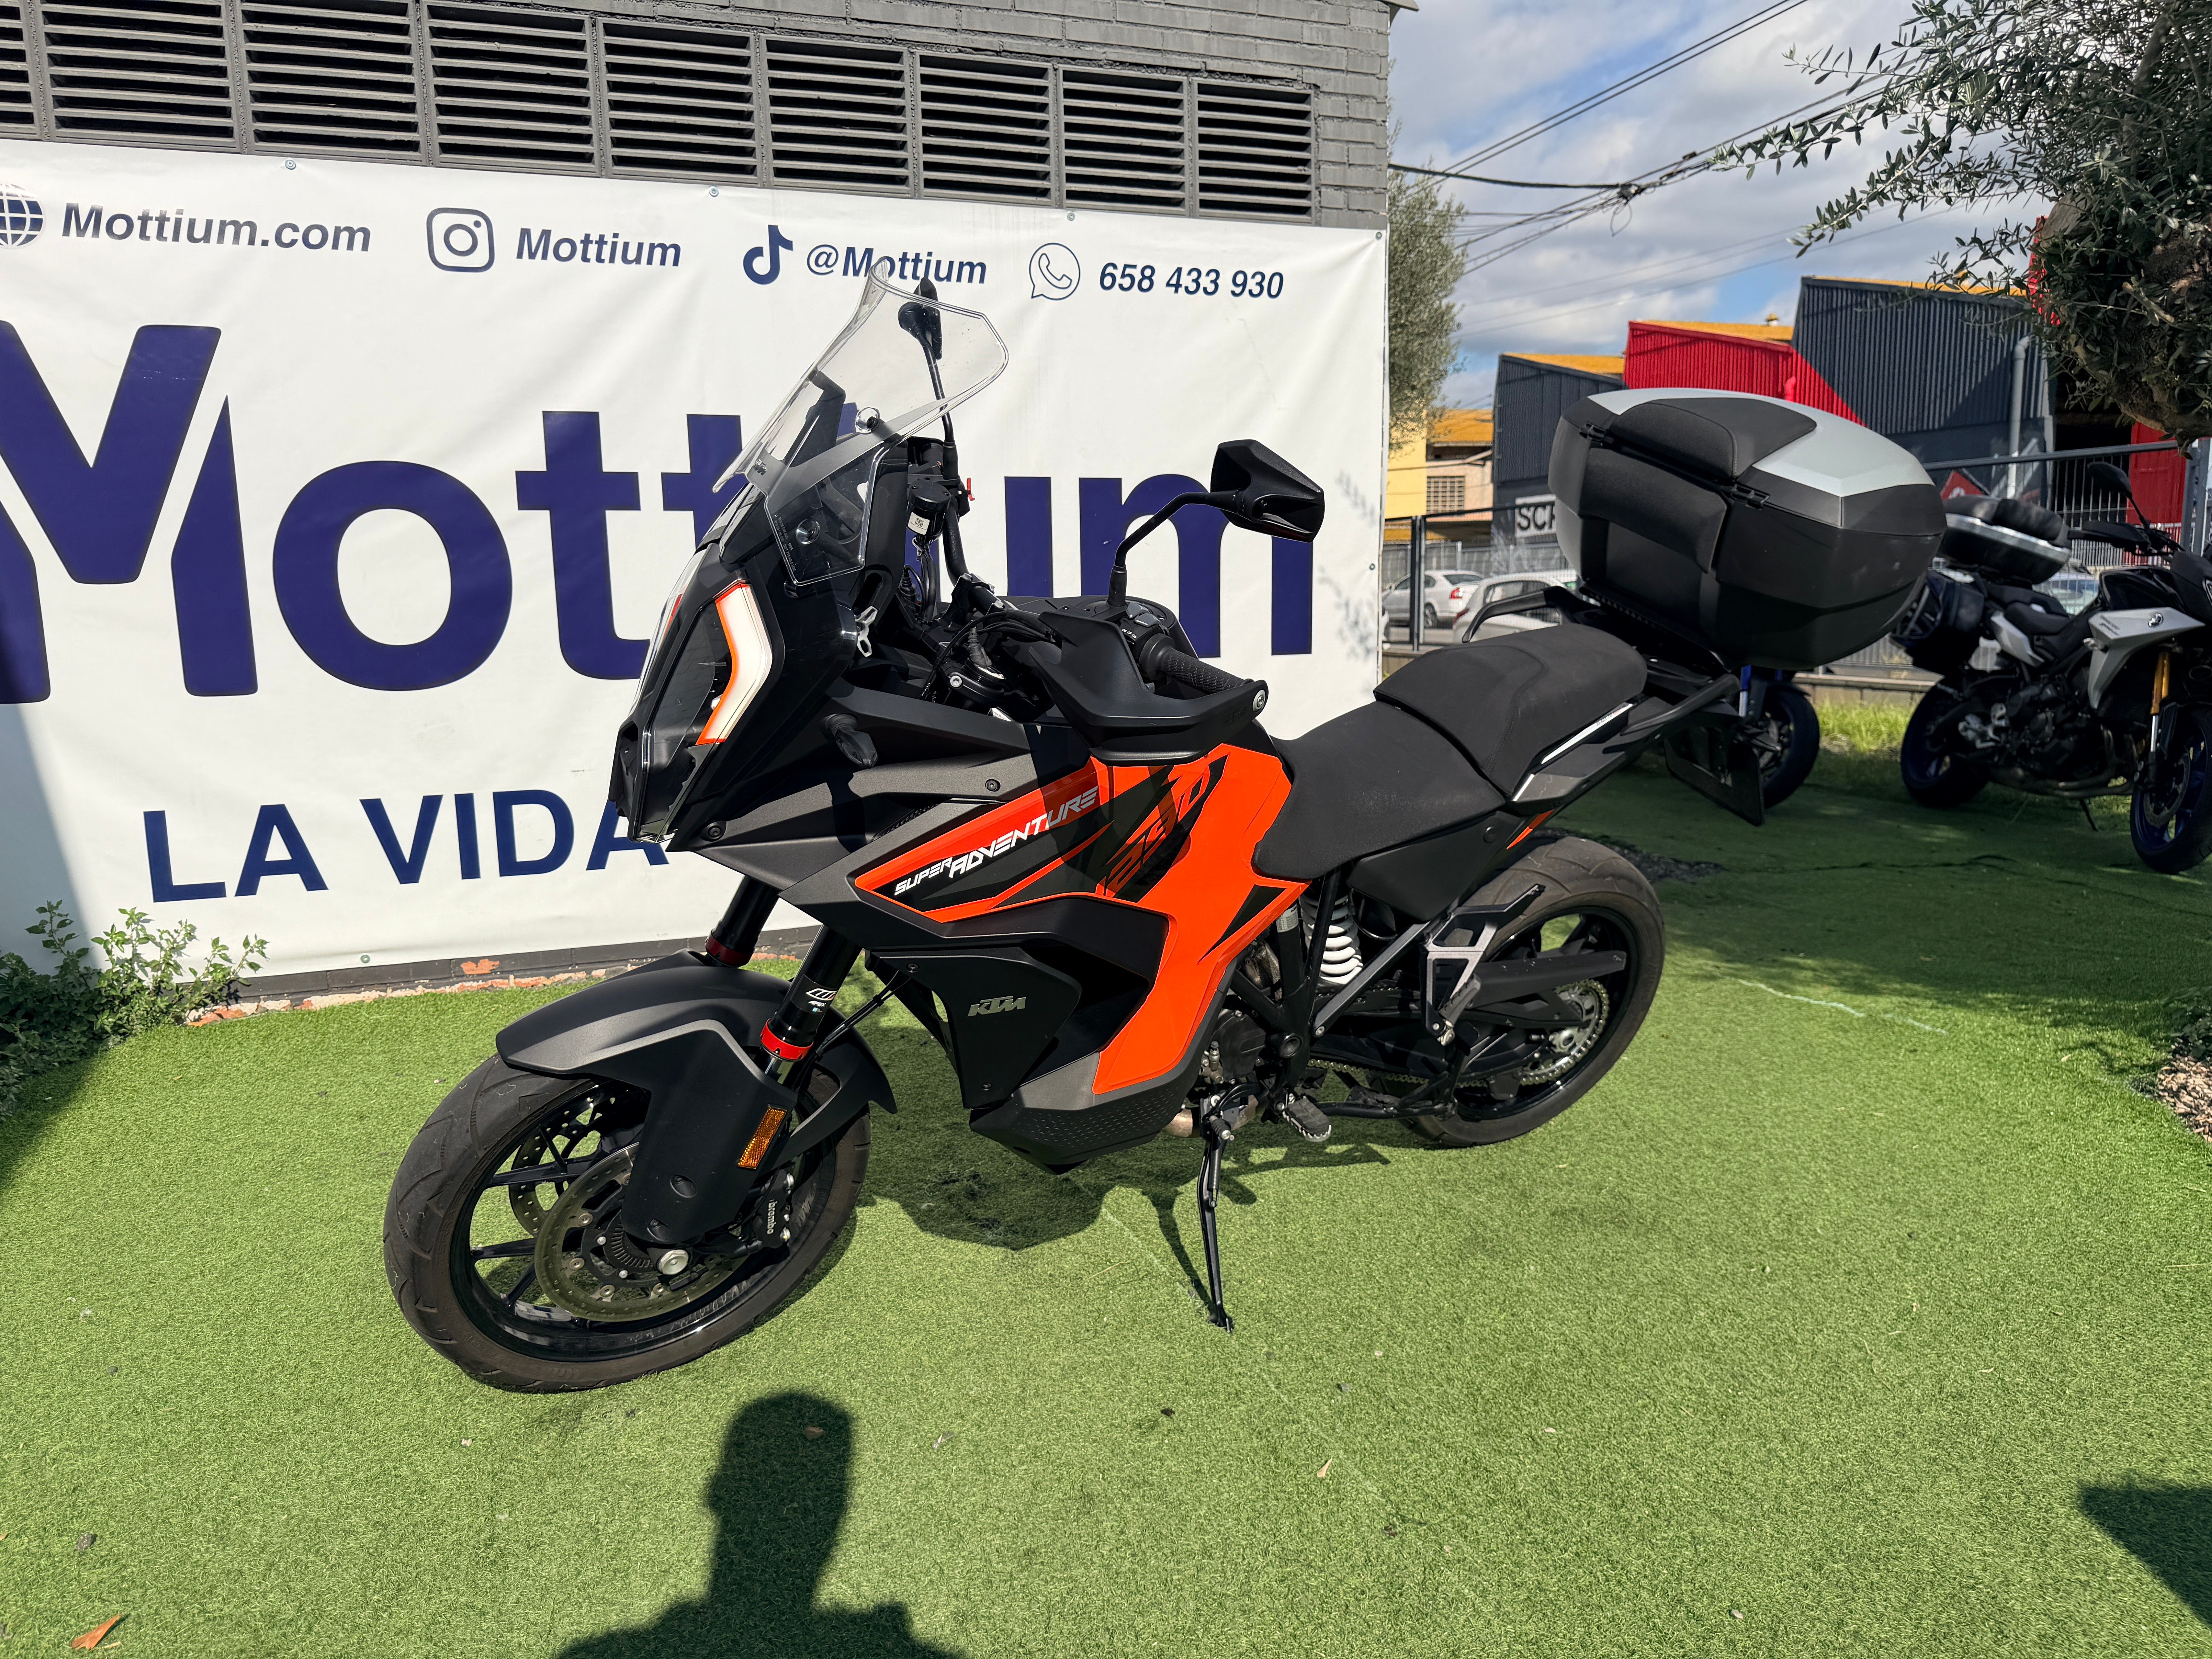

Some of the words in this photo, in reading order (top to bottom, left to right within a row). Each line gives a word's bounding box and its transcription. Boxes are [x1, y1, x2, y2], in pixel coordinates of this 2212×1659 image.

[62, 202, 371, 252] Mottium.com
[516, 227, 682, 267] Mottium
[1099, 262, 1156, 293] 658
[1165, 267, 1220, 296] 433
[1230, 270, 1284, 299] 930
[0, 319, 1314, 704] Mottm
[143, 803, 329, 903] LA
[894, 856, 953, 896] SUPER
[948, 786, 1099, 879] ADVENTURE
[967, 995, 1026, 1017] KTM
[766, 1200, 778, 1235] brembo
